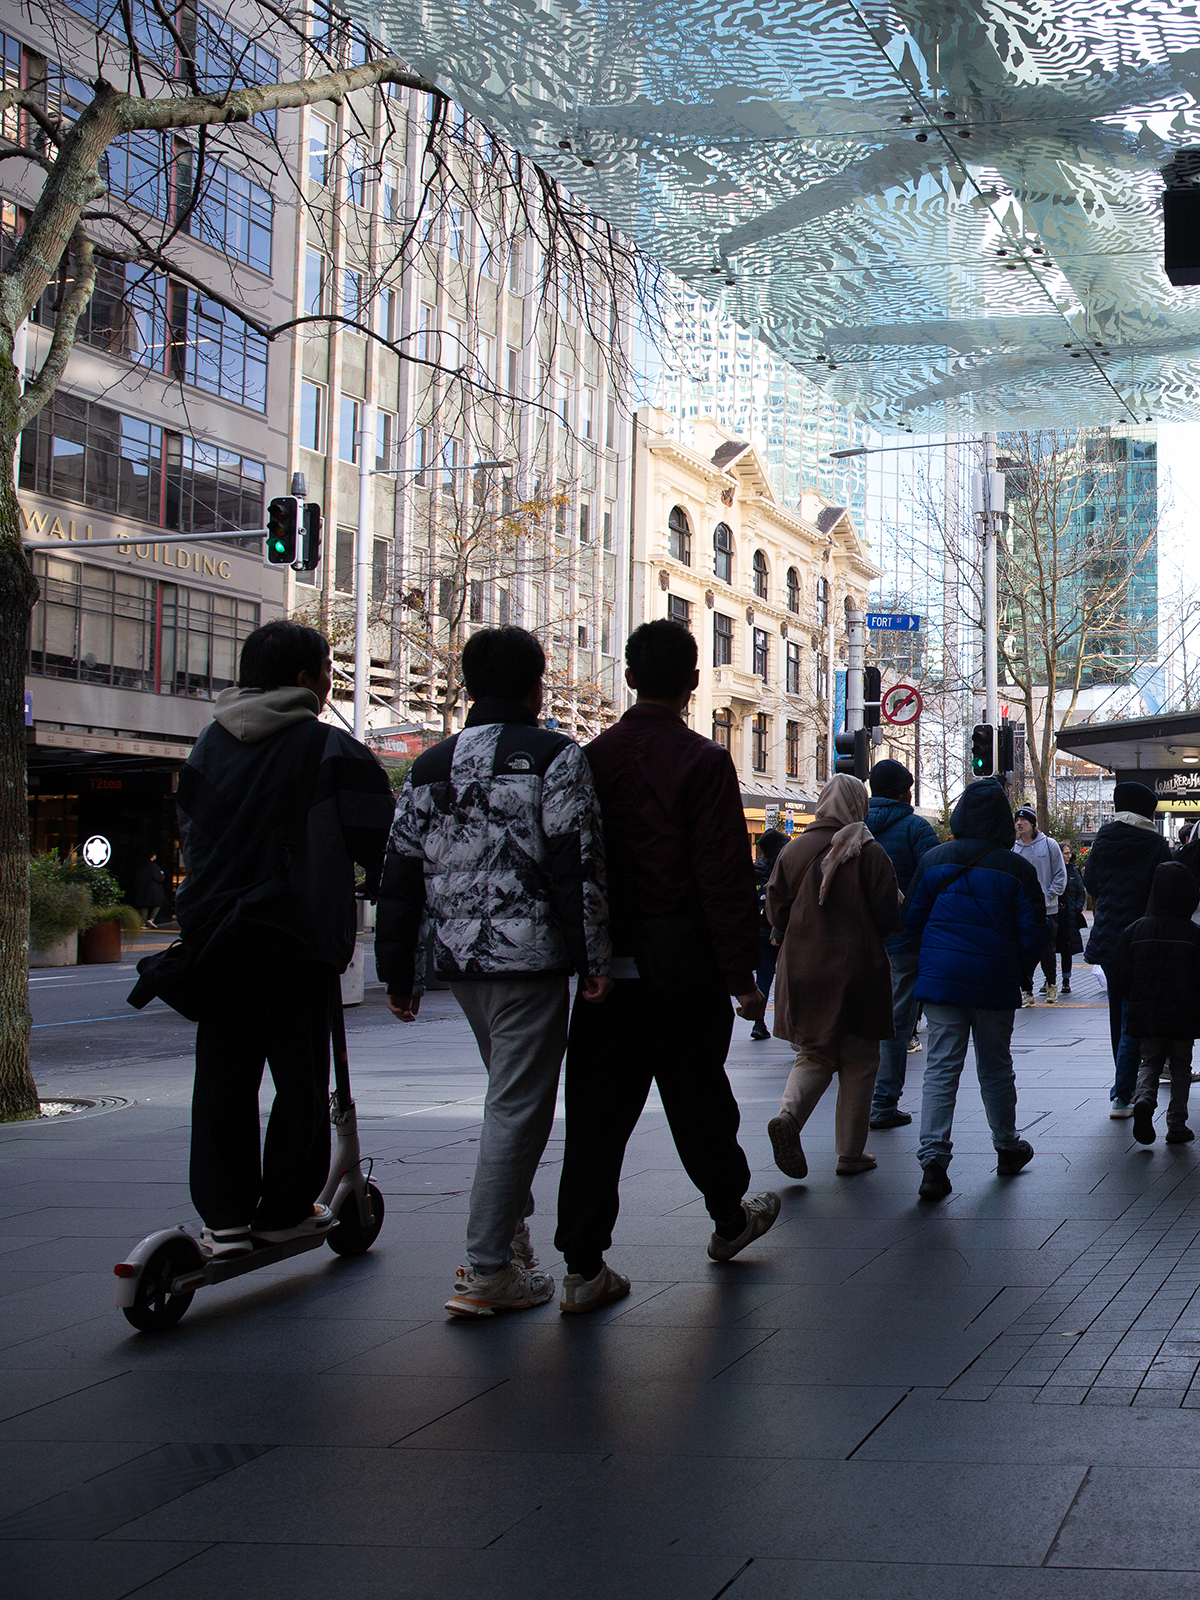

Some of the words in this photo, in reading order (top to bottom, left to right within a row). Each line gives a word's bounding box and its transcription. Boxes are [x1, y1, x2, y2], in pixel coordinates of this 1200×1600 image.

[117, 533, 232, 580] BUILDING
[871, 616, 893, 627] FORT
[89, 778, 122, 789] T2tea
